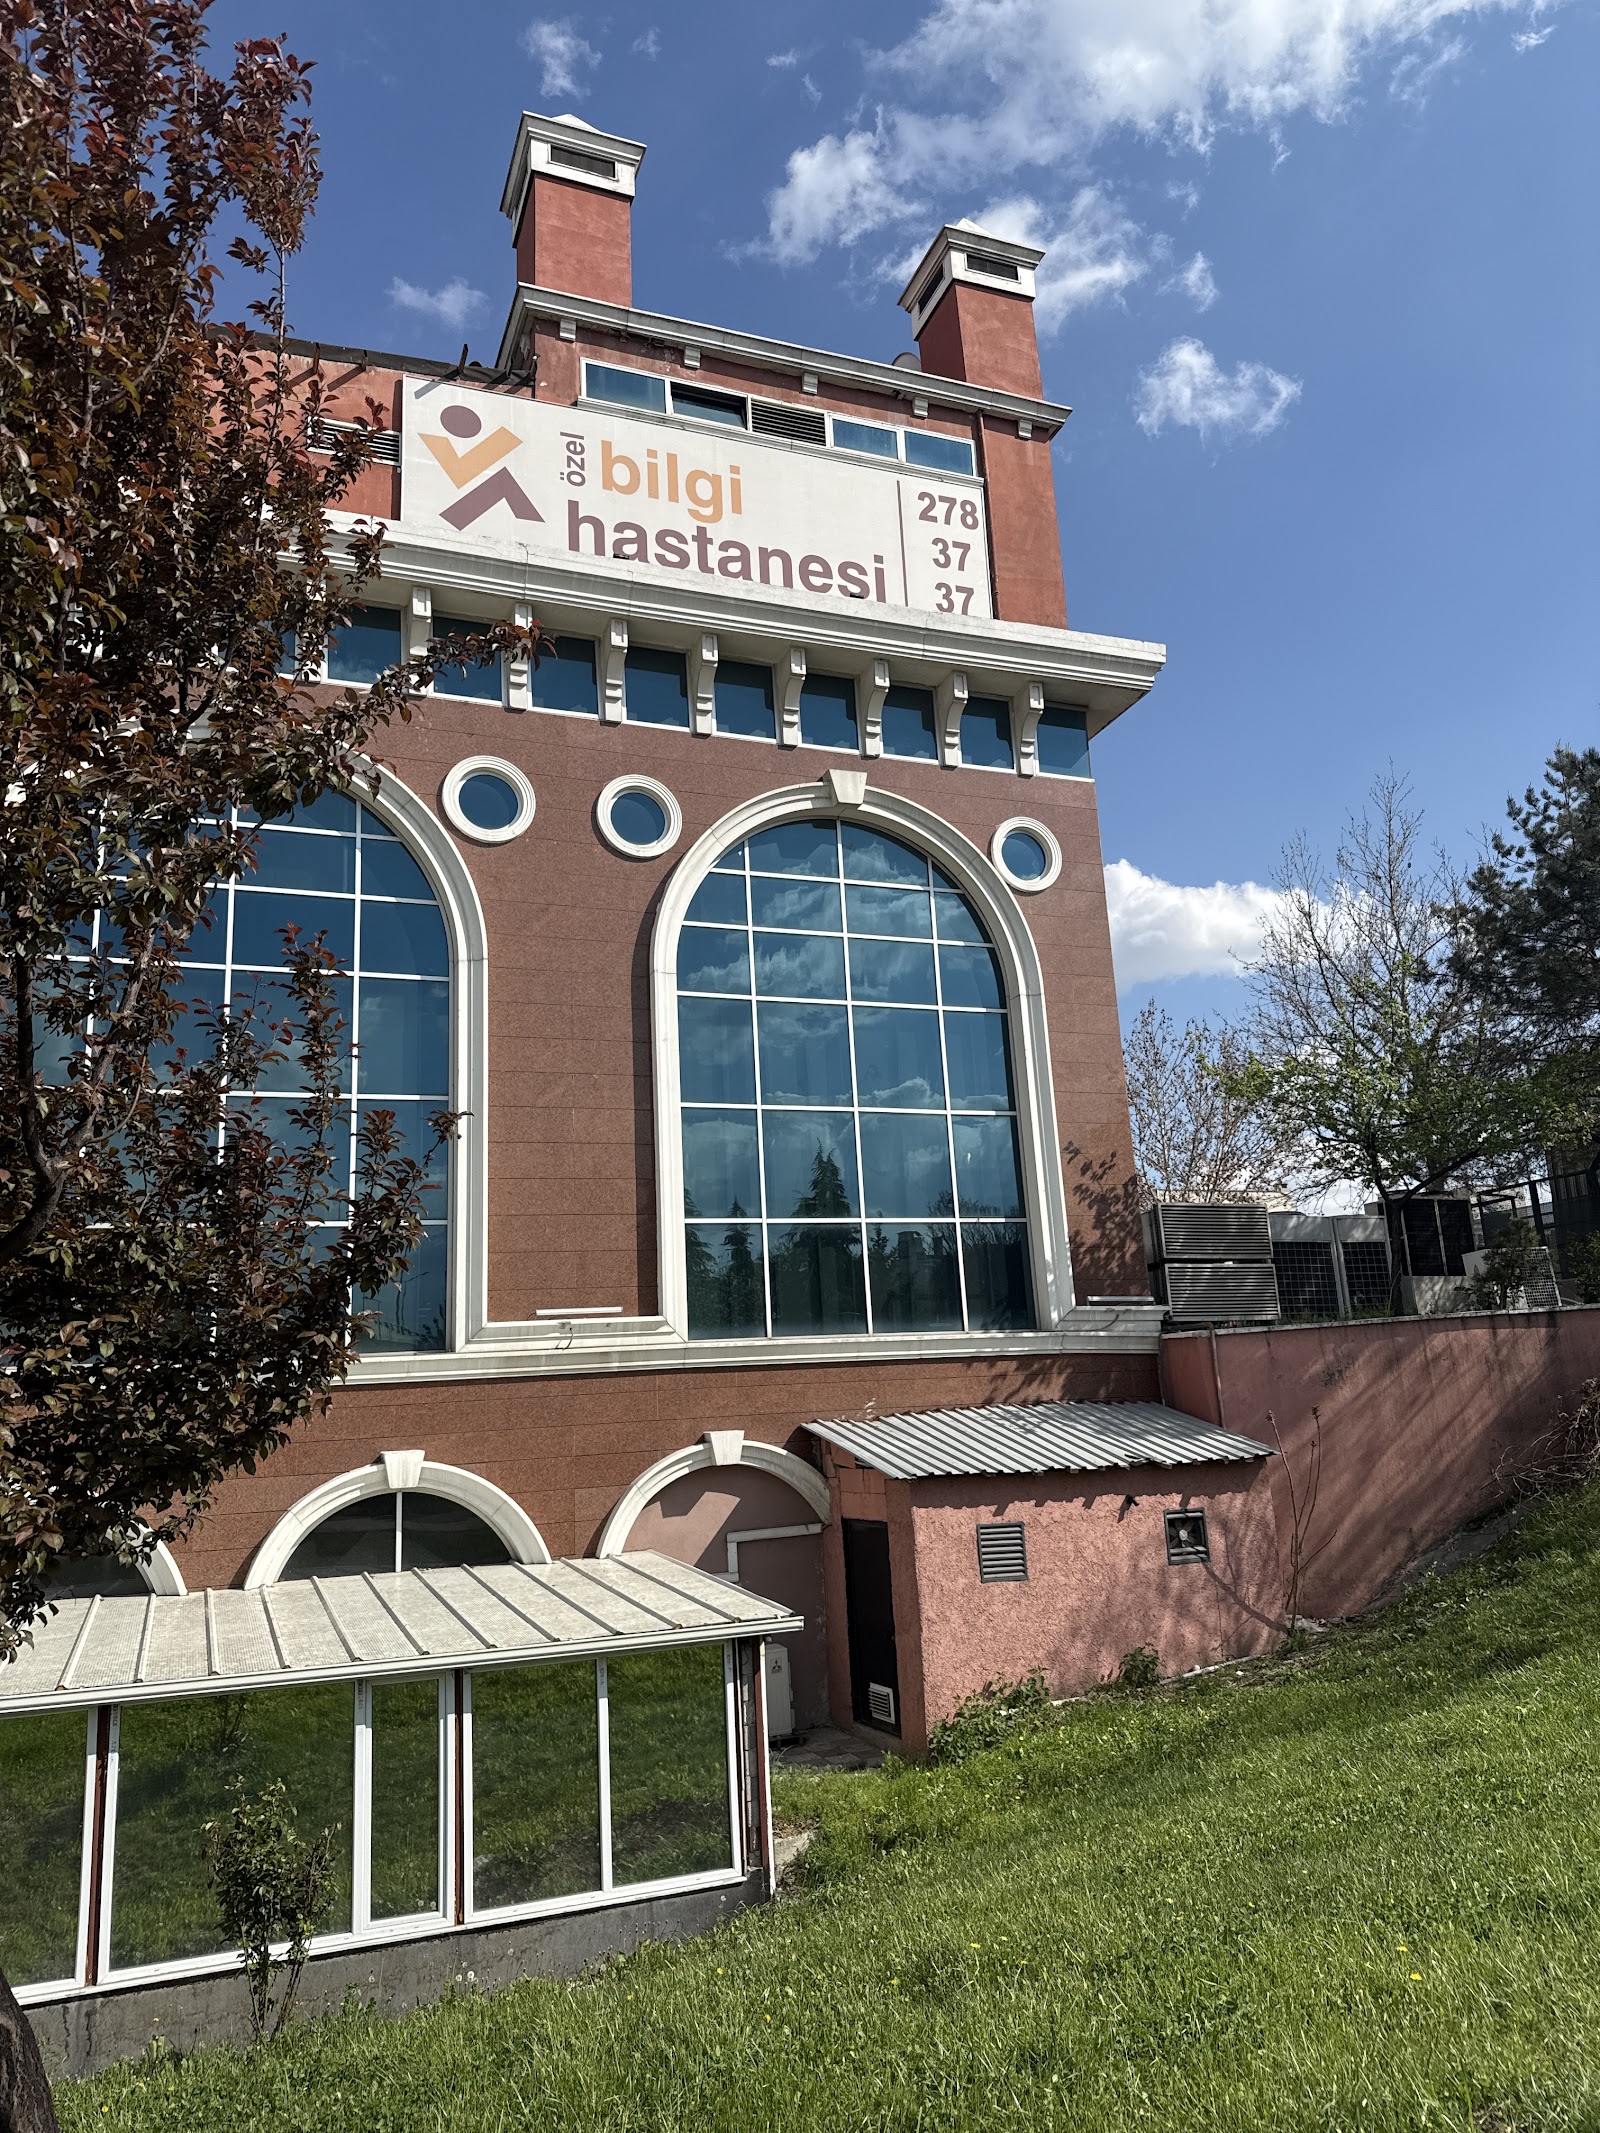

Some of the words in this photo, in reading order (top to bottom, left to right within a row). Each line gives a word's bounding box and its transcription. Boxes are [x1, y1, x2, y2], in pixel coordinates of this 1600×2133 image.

[560, 431, 586, 487] özel
[601, 439, 742, 524] bilgi
[917, 491, 979, 530] 278
[567, 499, 887, 603] hastanesi
[931, 537, 971, 572] 37
[934, 582, 975, 616] 37
